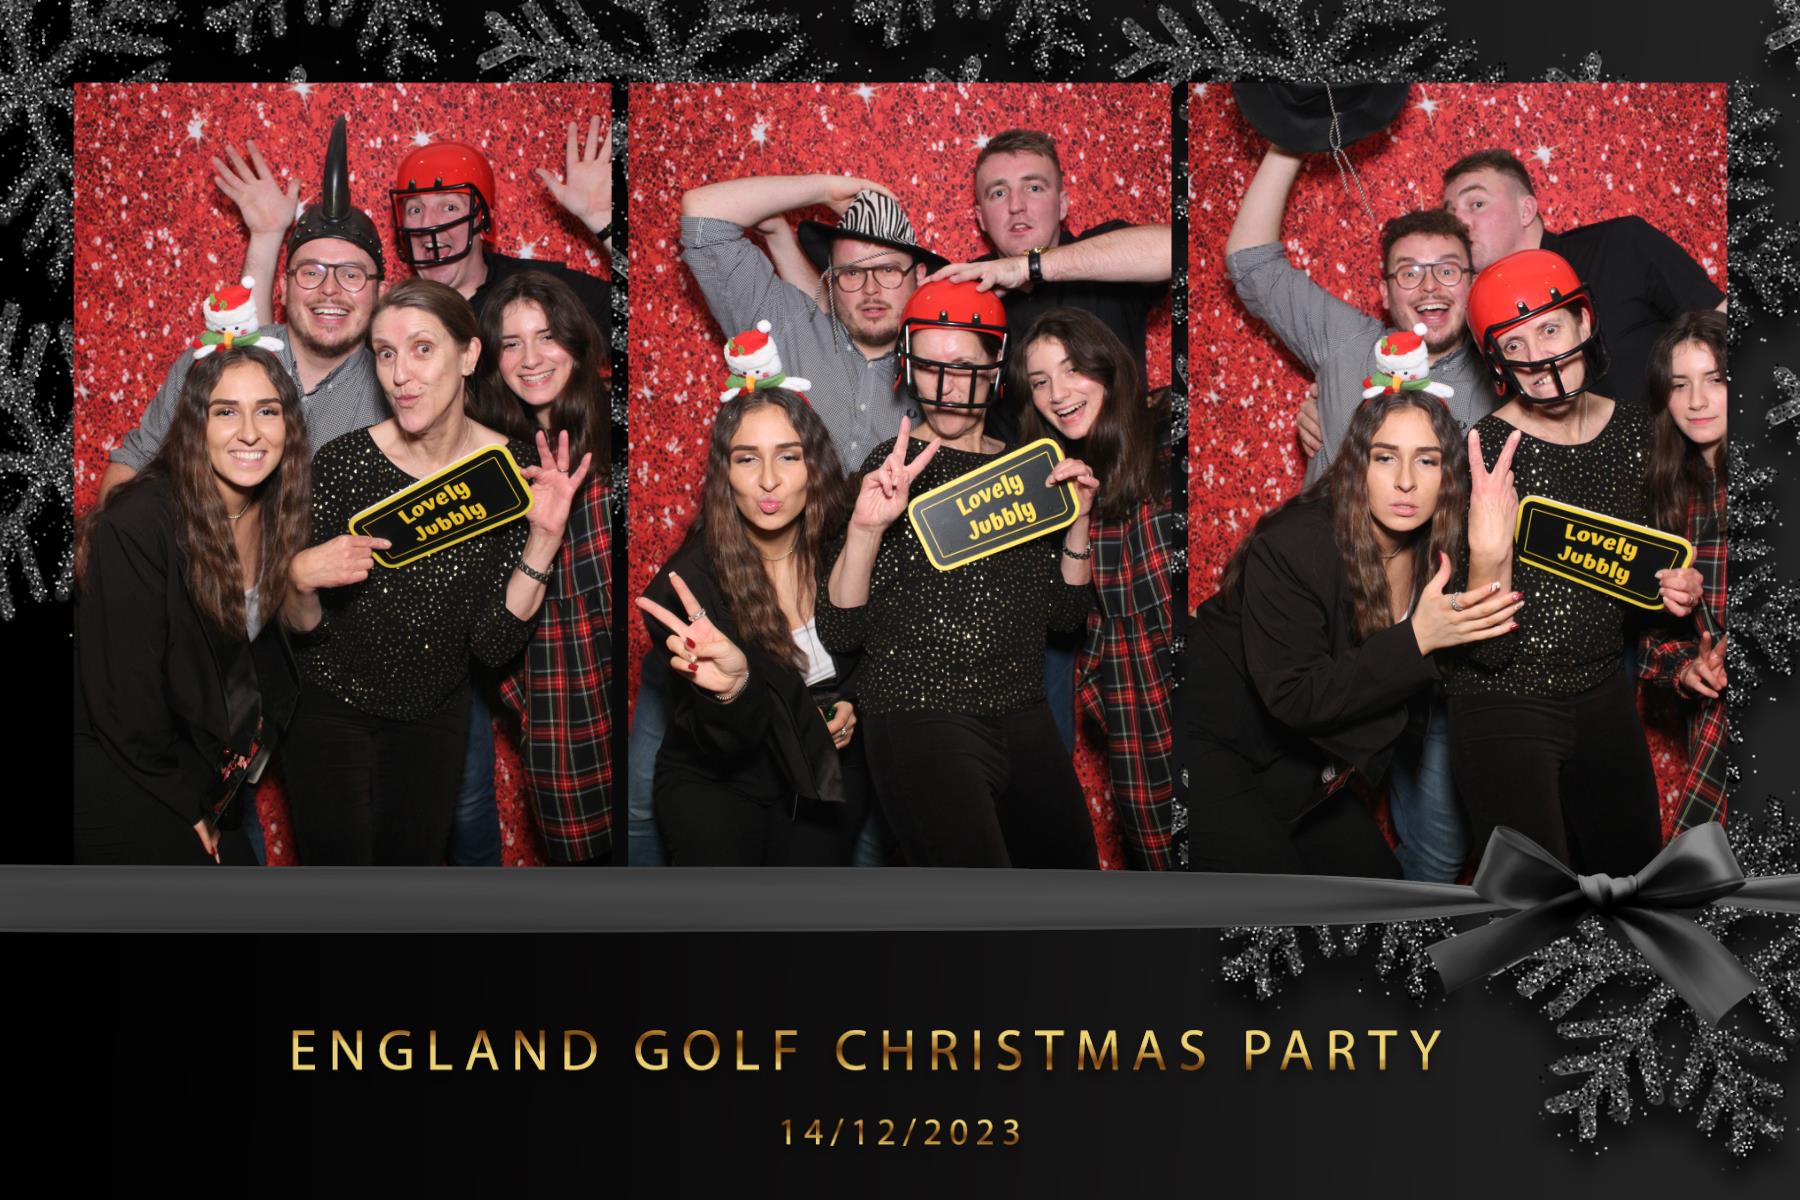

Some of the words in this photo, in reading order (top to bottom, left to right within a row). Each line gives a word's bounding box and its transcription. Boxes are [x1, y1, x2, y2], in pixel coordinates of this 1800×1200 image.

[397, 480, 472, 525] Lovely
[955, 473, 1025, 517] Lovely
[414, 502, 488, 542] Jubbly
[968, 500, 1037, 541] Jubbly
[1564, 523, 1639, 562] Lovely
[1557, 545, 1631, 586] Jubbly
